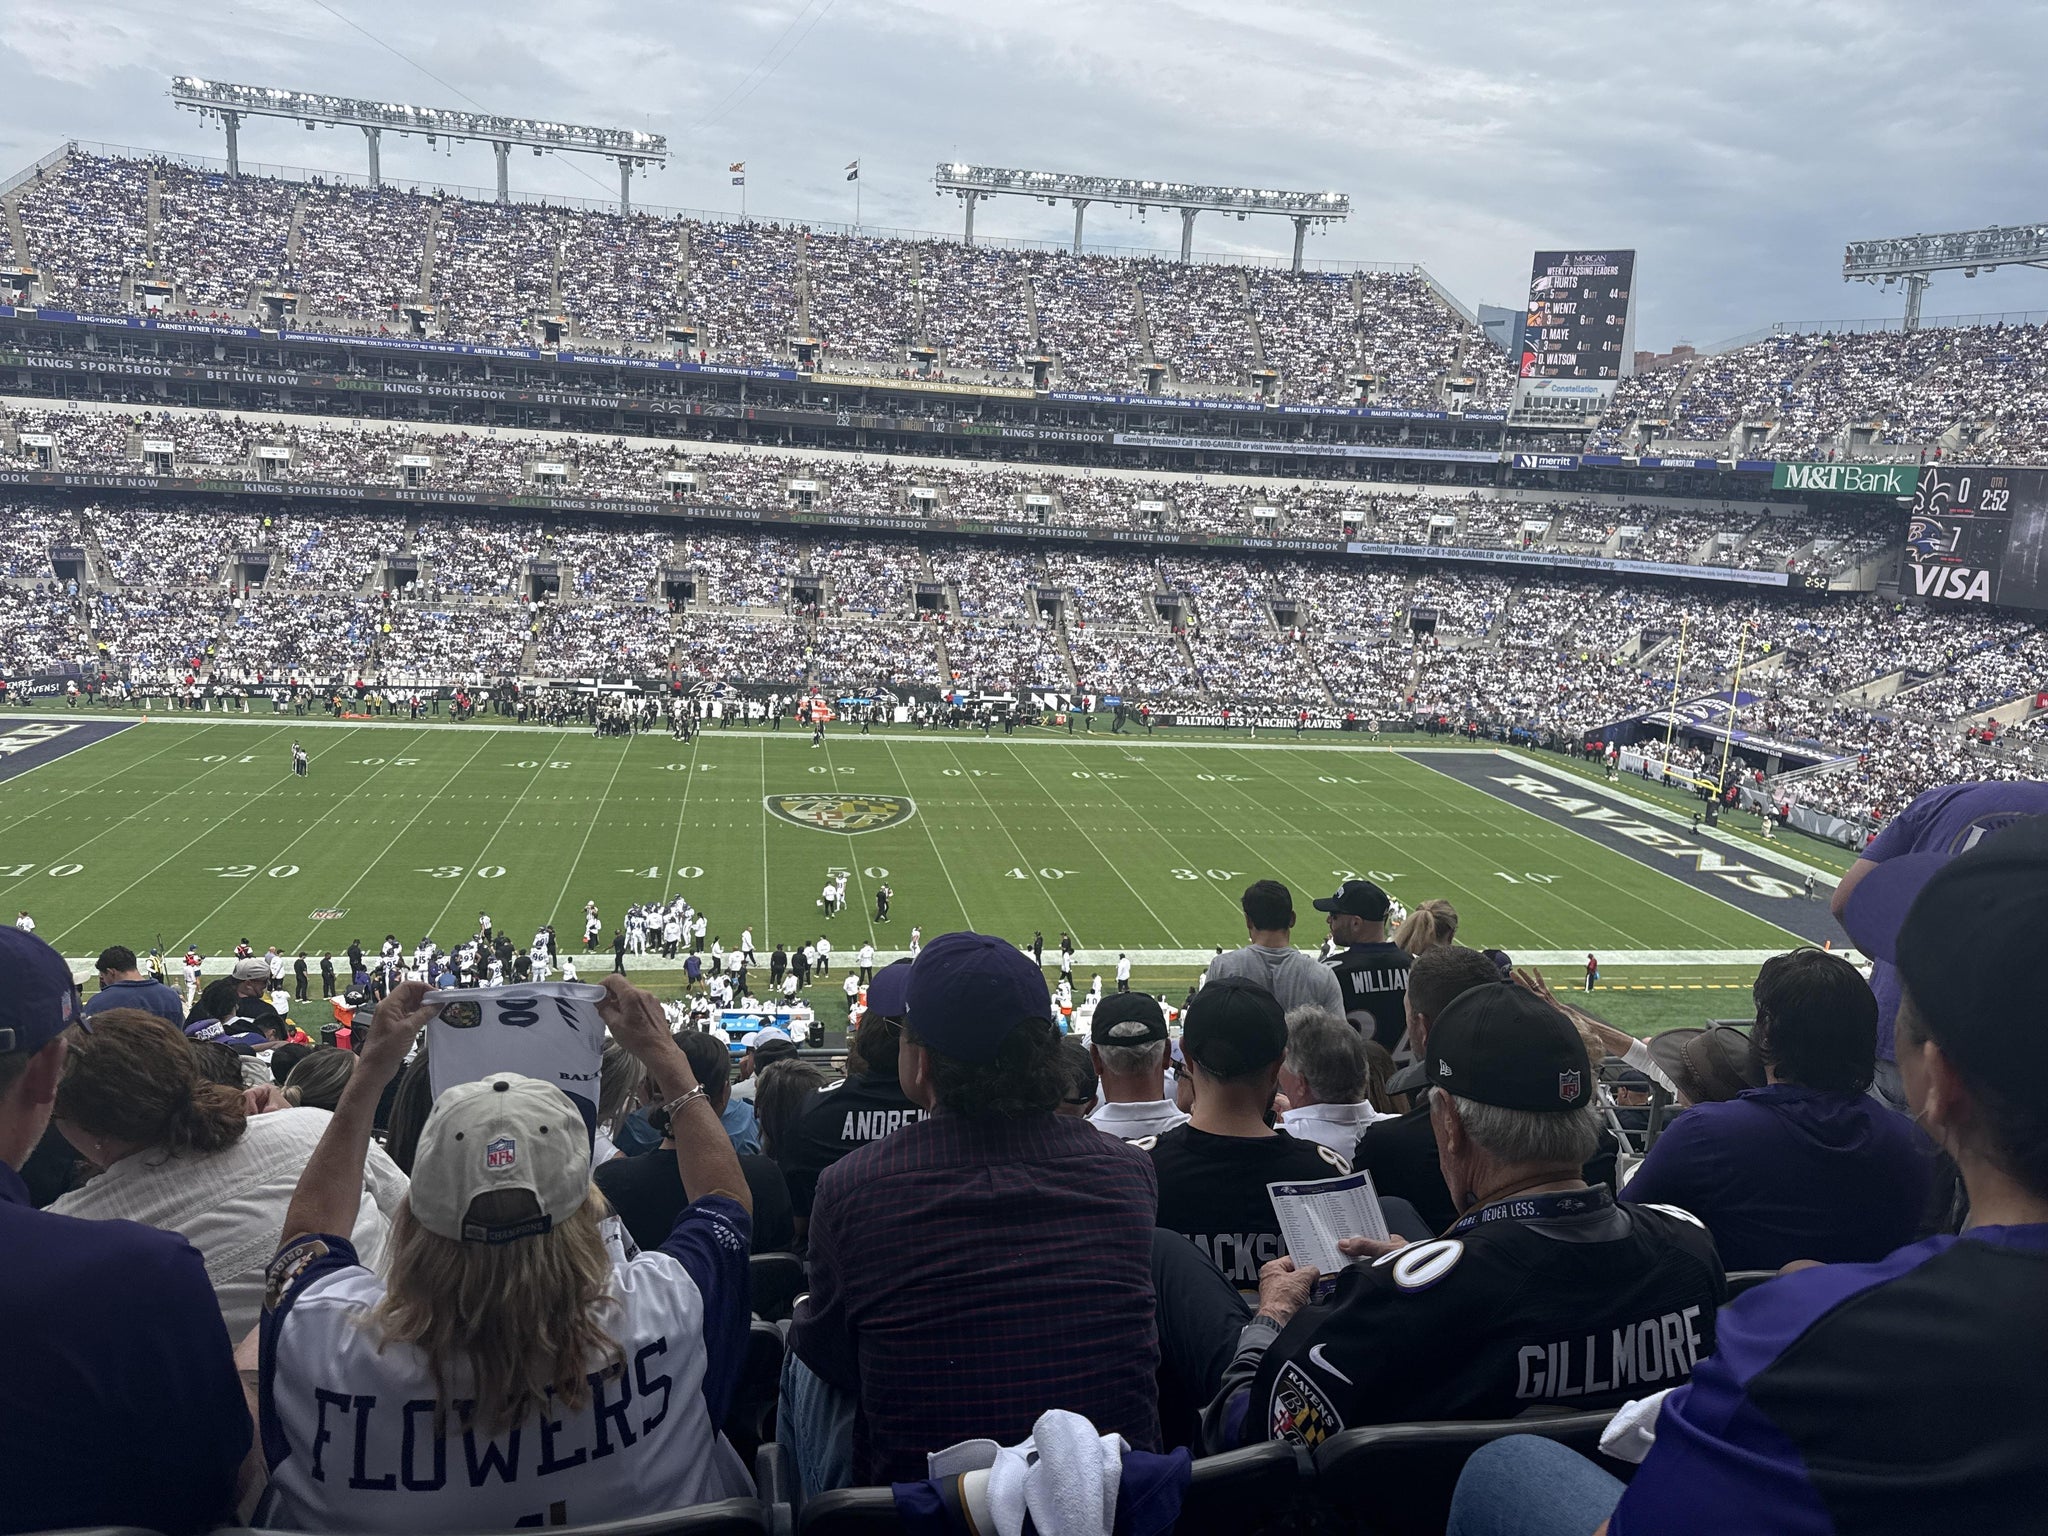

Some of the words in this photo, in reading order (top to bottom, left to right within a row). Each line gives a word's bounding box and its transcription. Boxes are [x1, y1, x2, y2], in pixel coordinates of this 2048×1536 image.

[1547, 266, 1568, 275] WEEKLY
[1569, 266, 1594, 276] PASSING
[1594, 266, 1619, 276] LEADERS
[1554, 276, 1578, 288] HURTS
[1549, 289, 1555, 299] 5
[1609, 288, 1619, 298] 44
[1553, 302, 1577, 314] WENTZ
[76, 315, 95, 323] RING
[100, 317, 128, 326] HONOR
[1546, 315, 1552, 325] 3
[1580, 315, 1586, 325] 6
[1605, 315, 1615, 325] 43
[156, 322, 187, 332] EARNEST
[188, 325, 210, 333] BYNER
[212, 326, 247, 336] 1996-2003
[1549, 328, 1570, 340] MAYE
[1543, 341, 1549, 351] 3
[1577, 341, 1582, 351] 4
[1602, 341, 1611, 351] 41
[601, 357, 627, 366] McCRARY
[1546, 353, 1577, 365] WATSON
[80, 361, 172, 377] SPORTSBOOK
[719, 367, 749, 375] BOULWARE
[1540, 366, 1546, 375] 4
[1573, 366, 1579, 376] 4
[1598, 366, 1609, 376] 37
[206, 370, 230, 380] BET
[235, 372, 263, 383] LIVE
[268, 375, 299, 385] NOW
[820, 376, 849, 384] JONATHAN
[428, 386, 506, 400] SPORTSBOOK
[1551, 384, 1598, 393] Constellation
[537, 394, 558, 403] BET
[562, 395, 587, 406] LIVE
[591, 398, 619, 408] NOW
[932, 422, 945, 433] 1:42
[1039, 431, 1105, 442] SPORTSBOOK
[1122, 435, 1151, 447] Gambling
[1152, 437, 1181, 447] Problem?
[1182, 438, 1193, 447] Call
[1194, 439, 1241, 450] 1-800-GAMBLER
[1250, 442, 1263, 450] visit
[1539, 456, 1571, 466] merritt
[64, 476, 88, 485] BET
[94, 477, 122, 486] LIVE
[128, 478, 159, 487] NOW
[288, 485, 365, 497] SPORTSBOOK
[1958, 477, 1971, 503] 0
[395, 491, 416, 500] BET
[420, 492, 445, 501] LIVE
[448, 494, 476, 503] NOW
[1980, 490, 2010, 512] 2:52
[590, 502, 660, 513] SPORTSBOOK
[687, 507, 706, 516] BET
[709, 509, 732, 518] LIVE
[735, 510, 761, 519] NOW
[864, 518, 928, 529] SPORTSBOOK
[1027, 527, 1088, 538] SPORTSBOOK
[1113, 532, 1130, 540] BET
[1133, 533, 1153, 541] LIVE
[1156, 535, 1180, 543] NOW
[1276, 540, 1338, 551] SPORTSBOOK
[1950, 527, 1961, 552] 7
[1361, 544, 1393, 555] Gambling
[1394, 546, 1426, 555] Problem?
[1427, 547, 1439, 556] Call
[1441, 549, 1494, 559] 1-800-GAMBLER
[1505, 552, 1519, 561] visit
[1805, 576, 1827, 589] 2:52
[1908, 563, 1990, 603] VISA
[20, 683, 59, 696] RAVENS!
[1305, 719, 1342, 729] RAVENS
[1485, 773, 1823, 901] RAVENS
[532, 953, 543, 961] 96
[1511, 1202, 1540, 1217] LESS.
[1515, 1304, 1702, 1400] GILLMORE
[1288, 1370, 1335, 1428] RAVENS
[312, 1336, 674, 1492] FLOWERS
